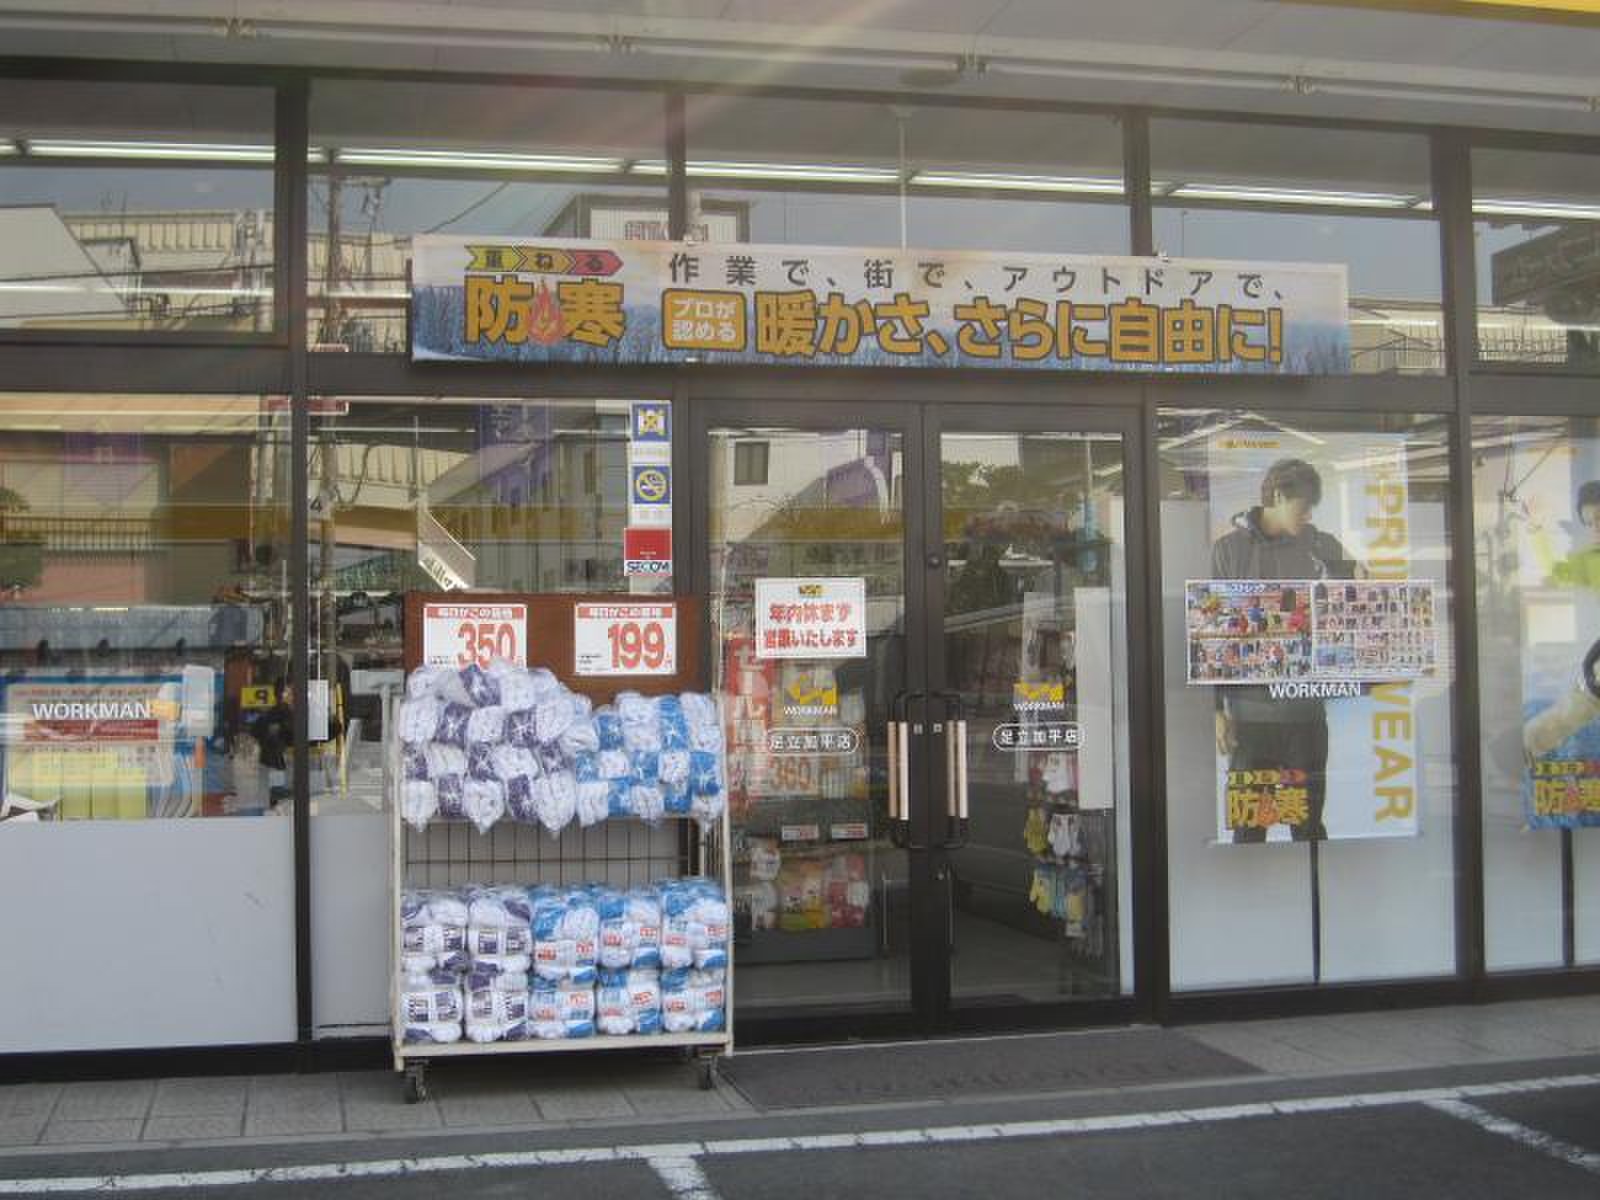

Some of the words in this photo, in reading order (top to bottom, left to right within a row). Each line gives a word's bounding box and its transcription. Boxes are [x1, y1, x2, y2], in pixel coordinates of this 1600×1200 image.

[670, 253, 1283, 299] 作業で、街で、アウトドアで、
[464, 274, 626, 347] 防寒
[672, 299, 736, 320] プロが
[671, 320, 737, 342] 認める
[626, 561, 670, 573] SECOM
[458, 623, 516, 670] 350
[608, 622, 665, 669] 199
[1269, 682, 1361, 699] WORKMAN
[32, 703, 150, 719] WORKMAN
